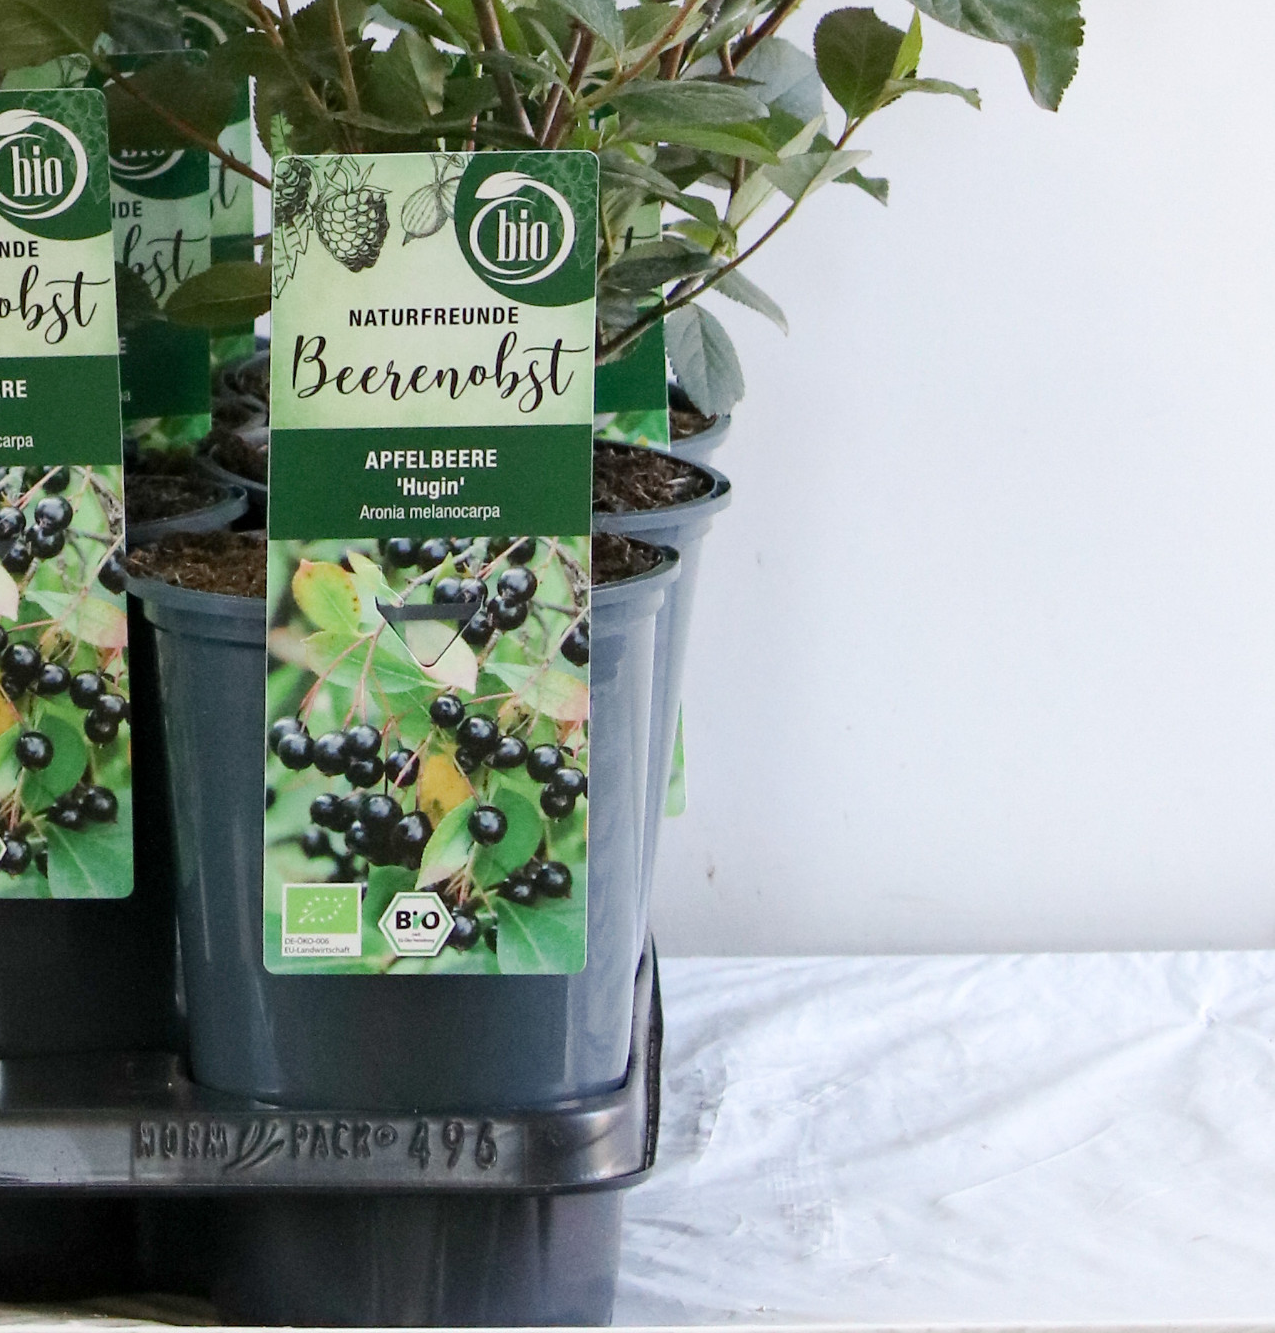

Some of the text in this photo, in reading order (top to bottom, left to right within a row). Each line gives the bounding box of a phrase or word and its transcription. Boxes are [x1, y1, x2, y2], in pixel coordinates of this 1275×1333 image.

[11, 145, 64, 198] bio
[496, 209, 550, 263] bio
[348, 306, 520, 327] NATURFREUNDE
[292, 331, 591, 414] Beerenobst
[364, 448, 498, 470] APFELBEERE
[396, 476, 465, 499] 'Hugin'
[359, 503, 501, 521] Aronia melanocarpa
[408, 1119, 499, 1171] 496
